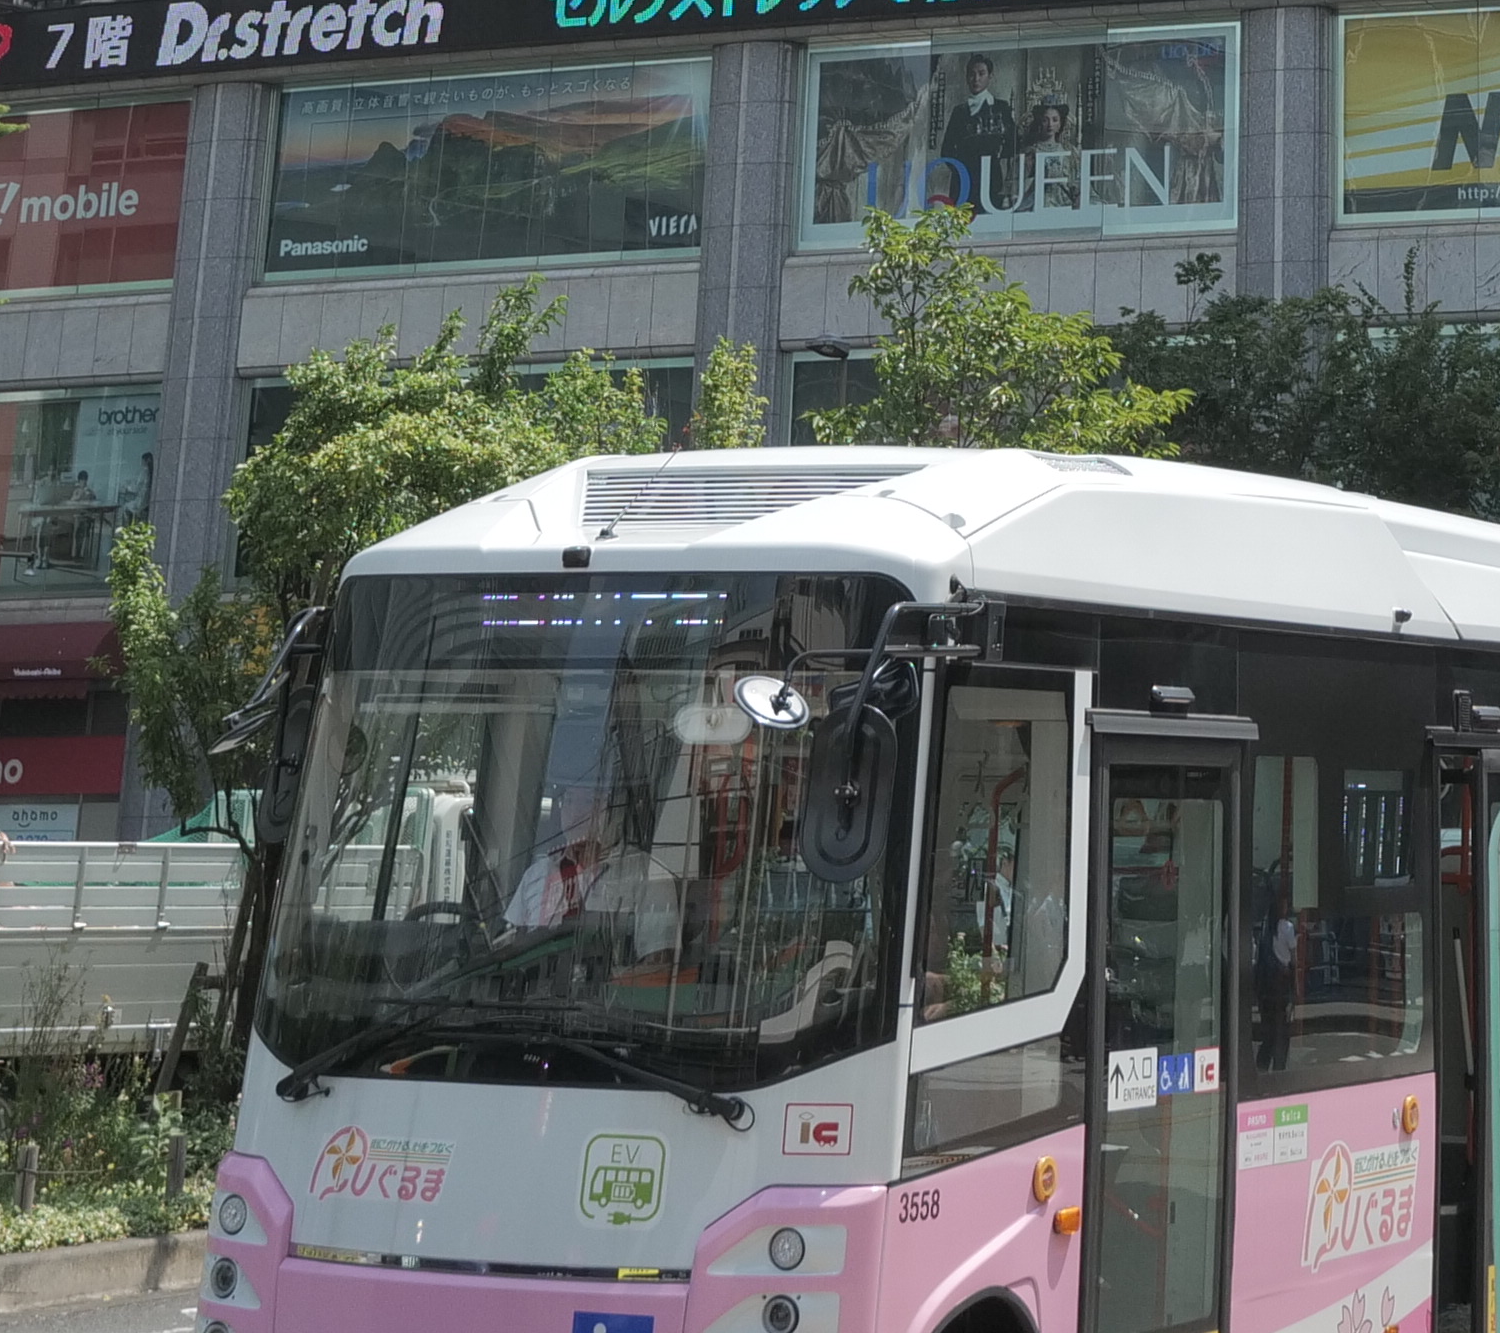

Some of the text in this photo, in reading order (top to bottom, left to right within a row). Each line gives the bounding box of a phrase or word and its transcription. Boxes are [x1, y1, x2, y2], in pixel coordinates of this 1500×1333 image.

[279, 234, 369, 258] Panasonic
[98, 406, 160, 427] brother
[12, 809, 58, 822] ahamo
[1128, 1056, 1154, 1081] 入口
[1123, 1085, 1155, 1102] ENTRANCE
[611, 1144, 641, 1164] EV
[900, 1190, 941, 1223] 3558
